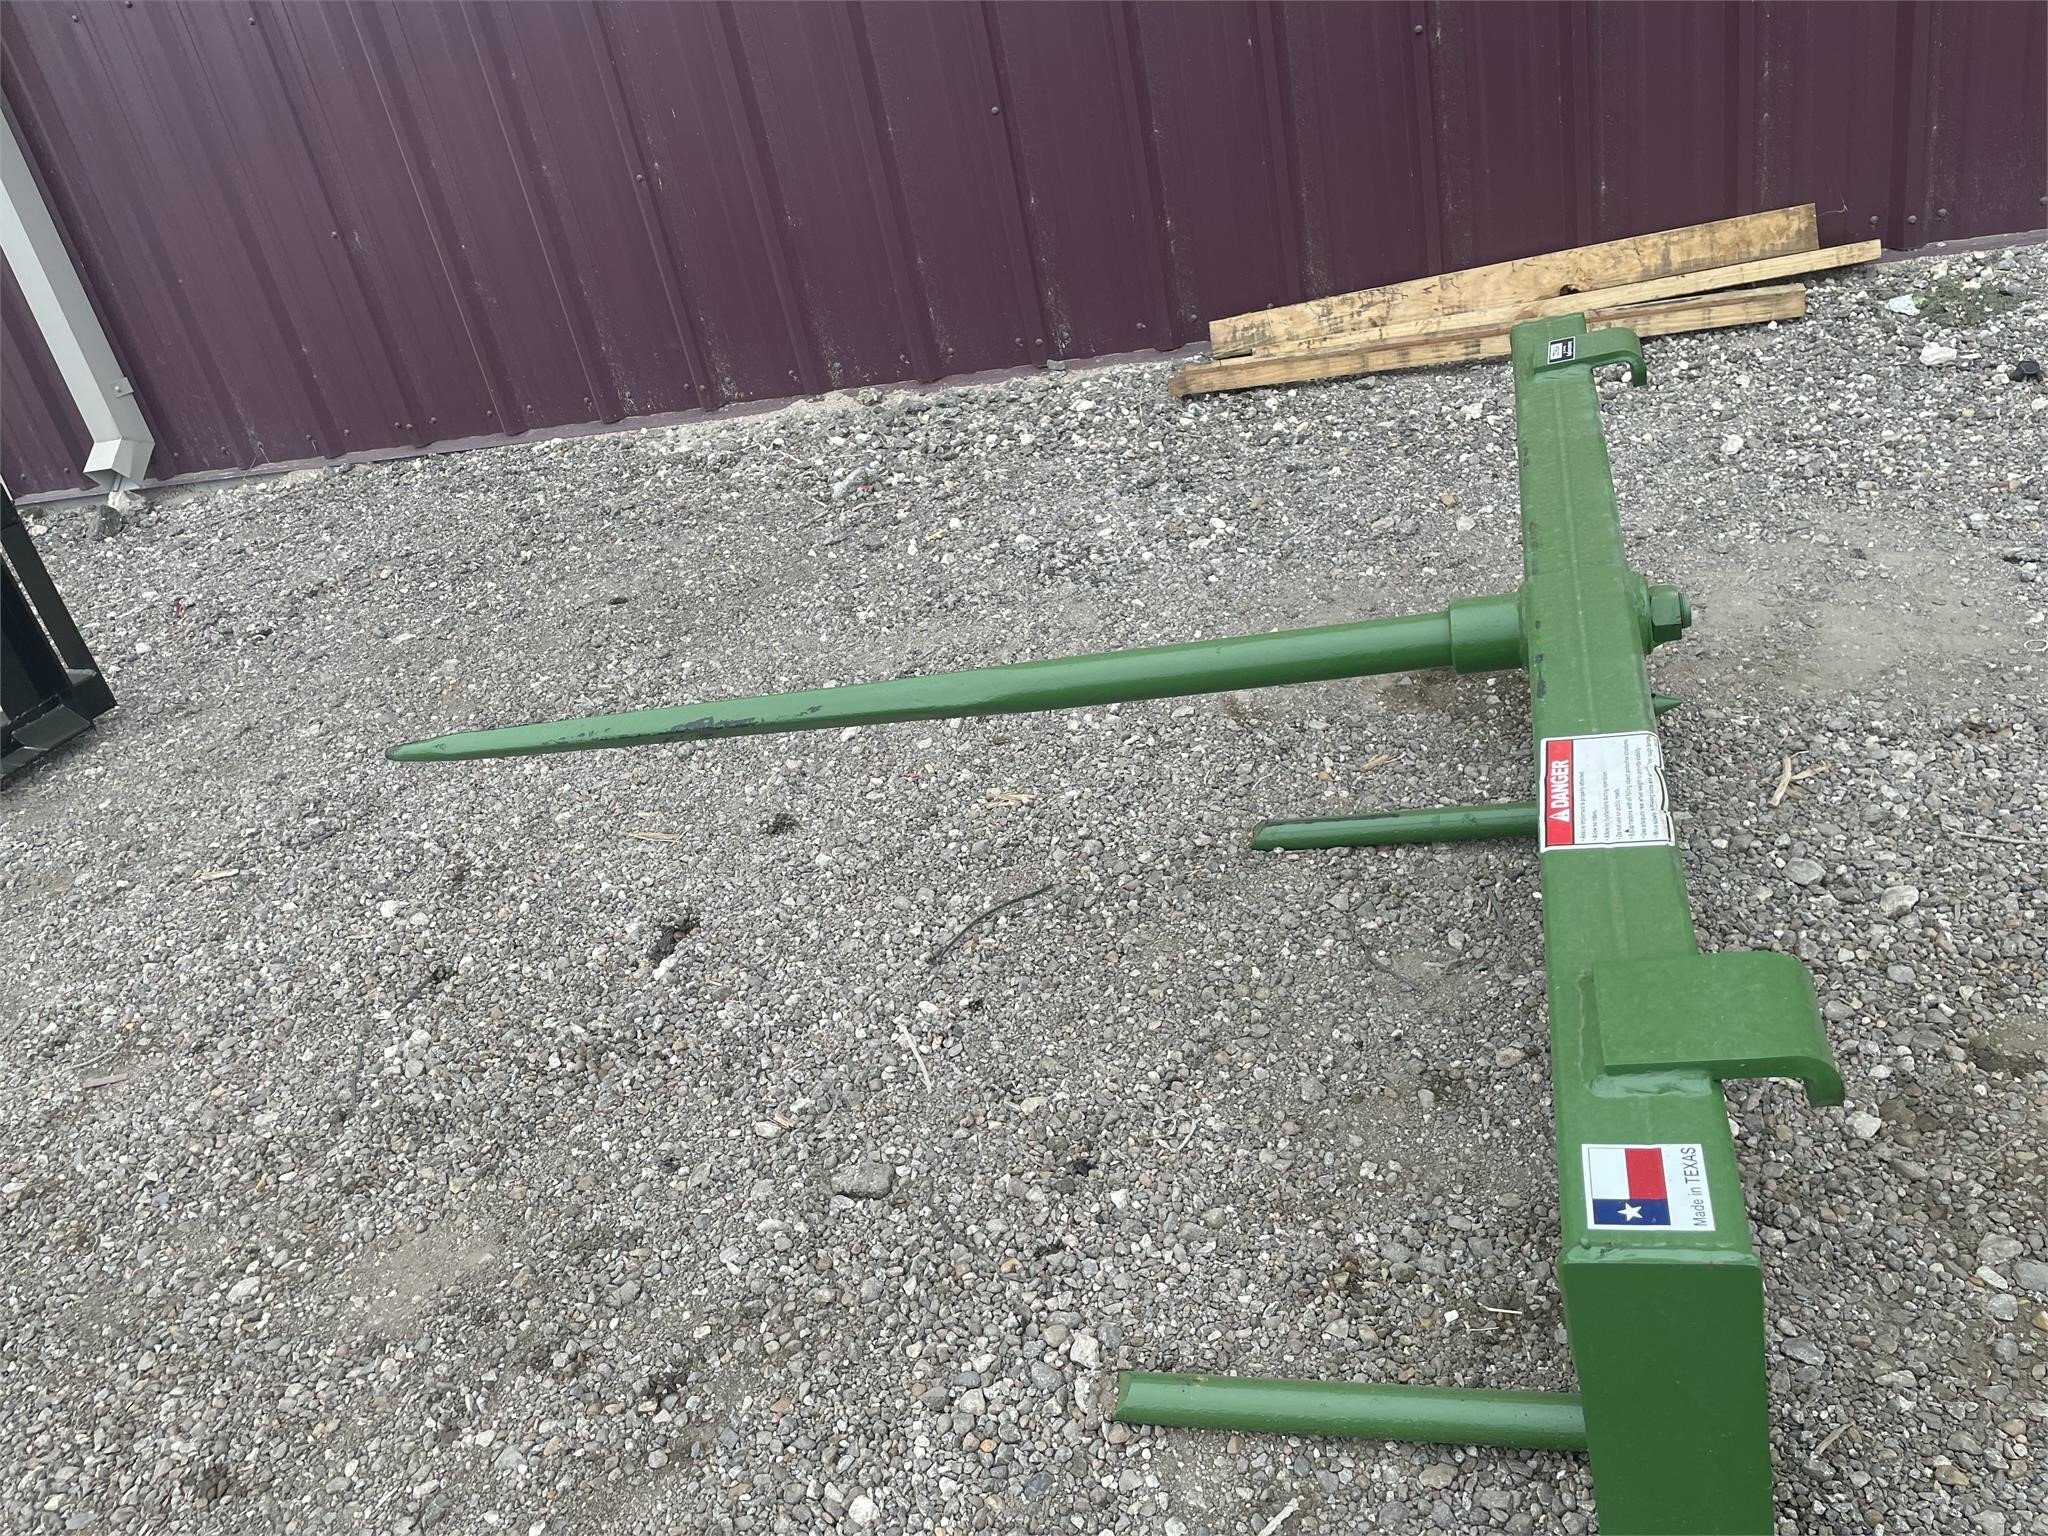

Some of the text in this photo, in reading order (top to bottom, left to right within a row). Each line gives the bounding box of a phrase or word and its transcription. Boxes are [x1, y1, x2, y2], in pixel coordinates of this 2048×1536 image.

[1550, 760, 1569, 808] DANGER
[1680, 1147, 1707, 1226] Made in TEXAS
